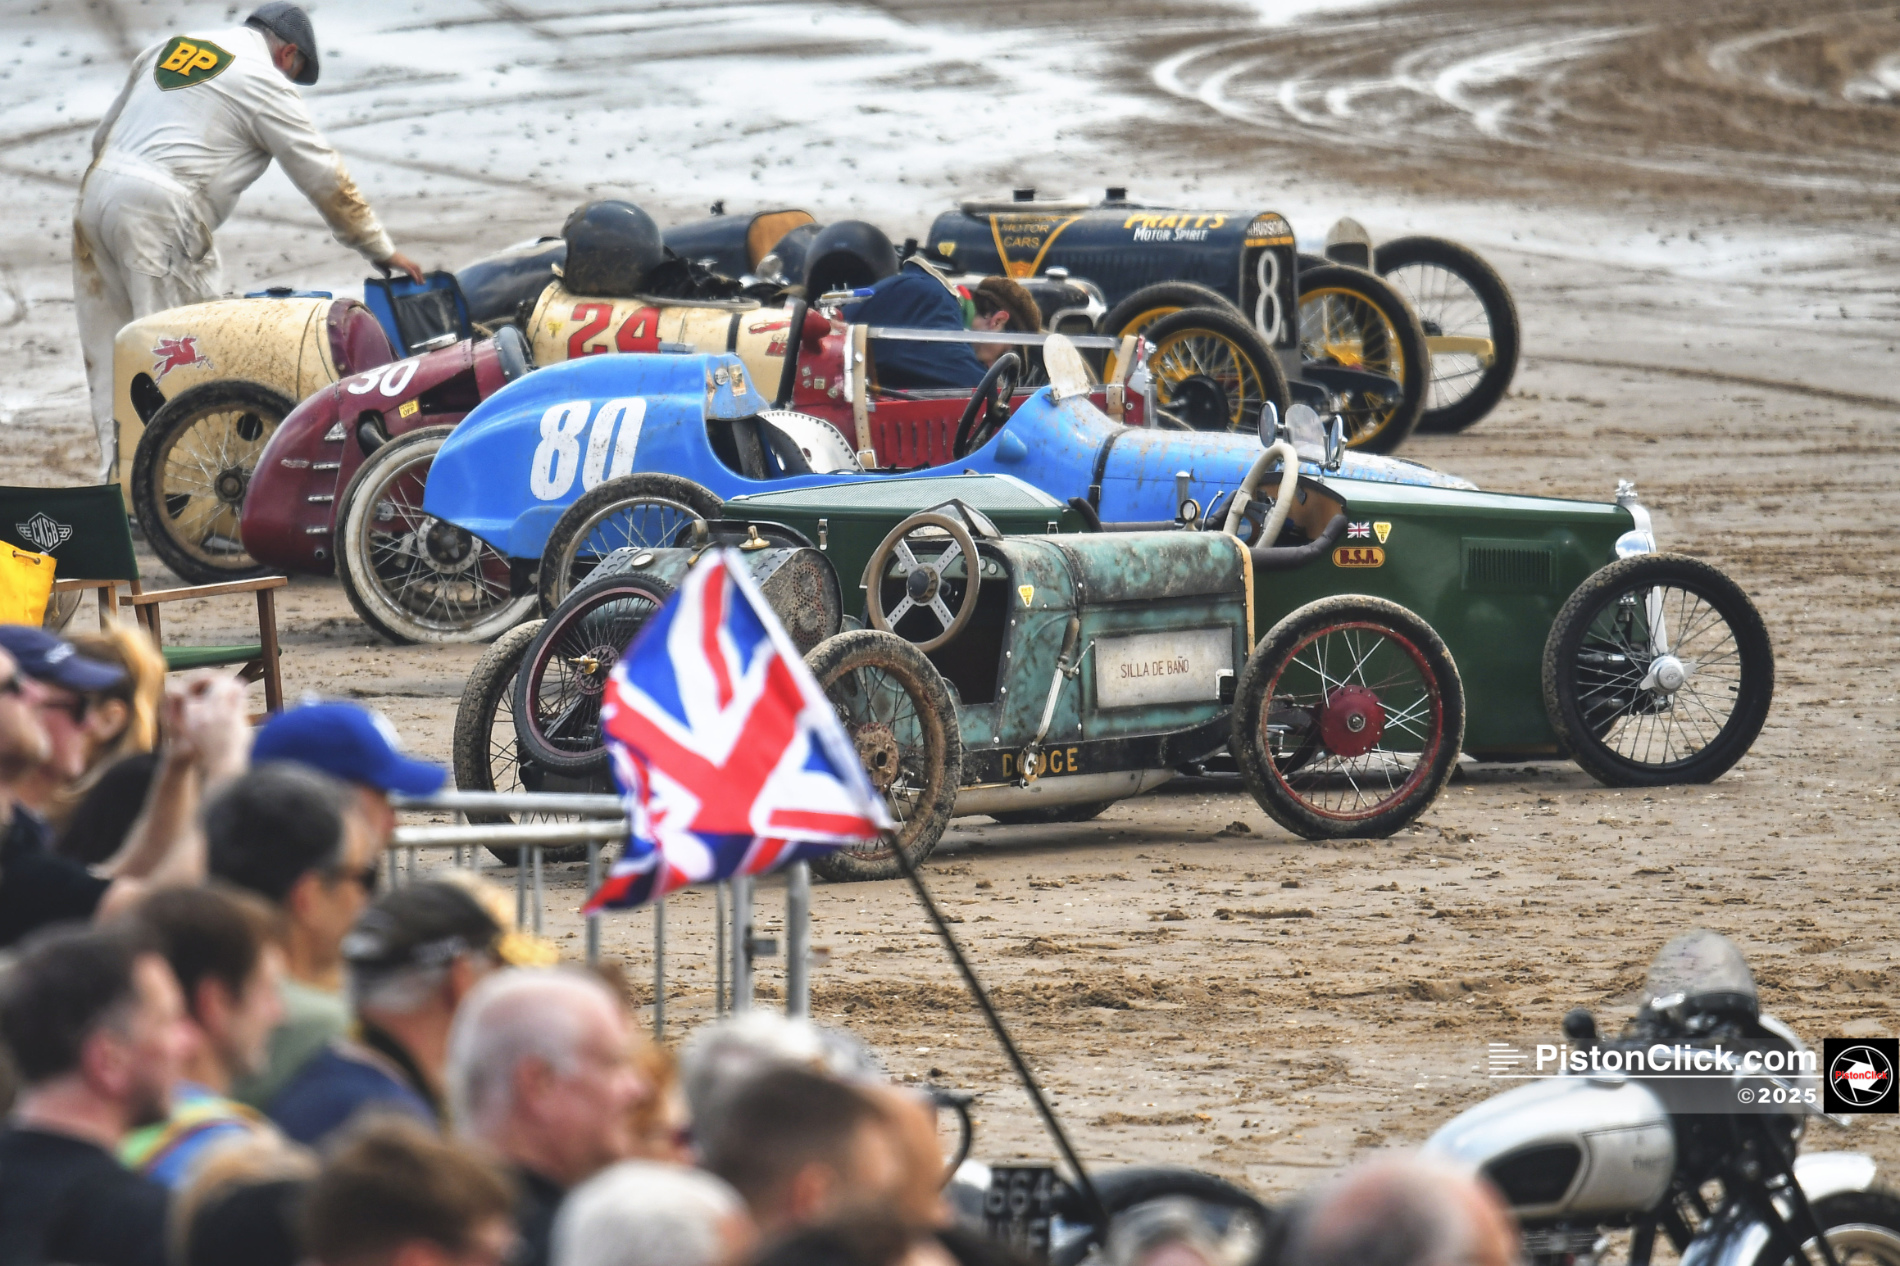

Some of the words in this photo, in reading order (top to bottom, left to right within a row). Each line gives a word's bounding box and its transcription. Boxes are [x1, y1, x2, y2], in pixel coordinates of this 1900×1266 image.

[159, 42, 218, 77] BP
[1001, 223, 1050, 234] MOTOR
[1133, 227, 1172, 242] MOTOR
[1172, 226, 1209, 242] SPIRIT
[1003, 236, 1041, 249] CARS
[1255, 250, 1282, 347] 8
[567, 303, 663, 361] 24
[529, 398, 648, 501] 80
[1340, 549, 1379, 565] B.S.A.
[1120, 661, 1150, 679] SILLA
[1152, 660, 1164, 677] DE
[1167, 655, 1190, 675] BAÑO
